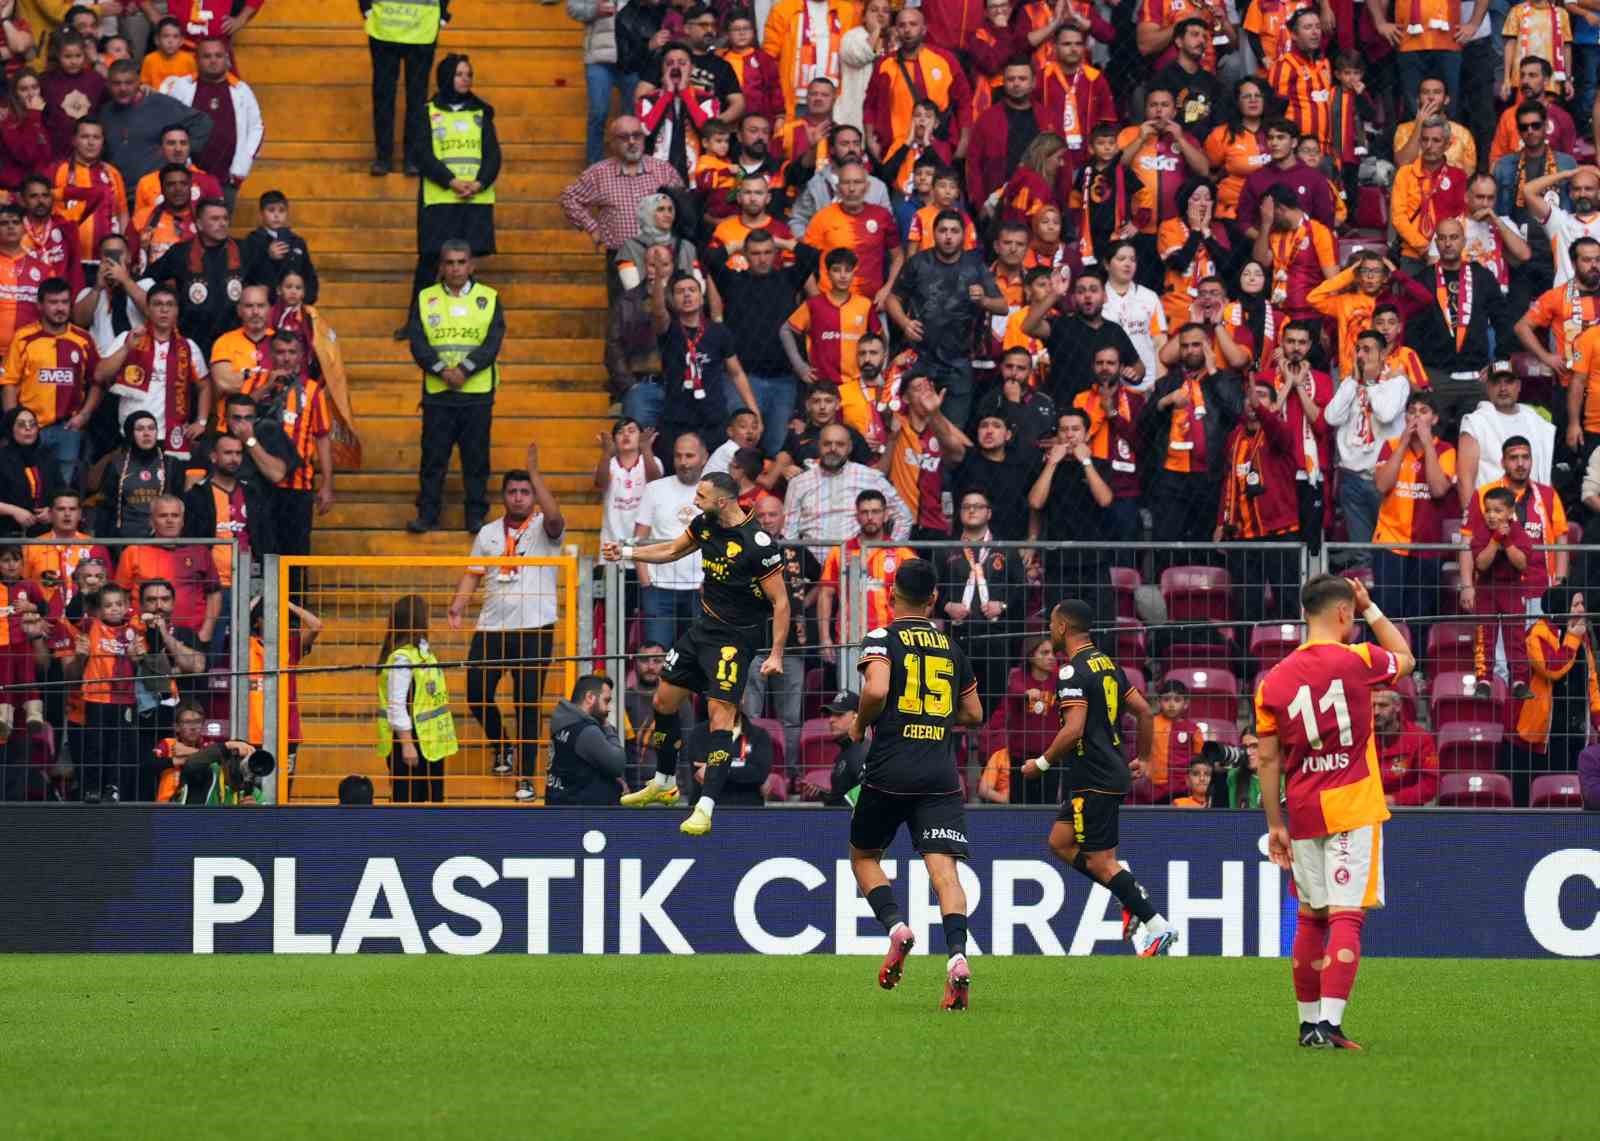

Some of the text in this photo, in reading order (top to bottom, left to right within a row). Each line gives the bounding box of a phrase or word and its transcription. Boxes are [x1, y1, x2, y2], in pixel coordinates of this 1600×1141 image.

[433, 327, 481, 340] 2373-265
[38, 369, 74, 383] avea
[715, 658, 738, 683] 11
[897, 653, 955, 718] 15
[1287, 678, 1354, 751] 11
[931, 827, 969, 843] PASHA
[193, 829, 1282, 958] PLASTİK CERRAHİ
